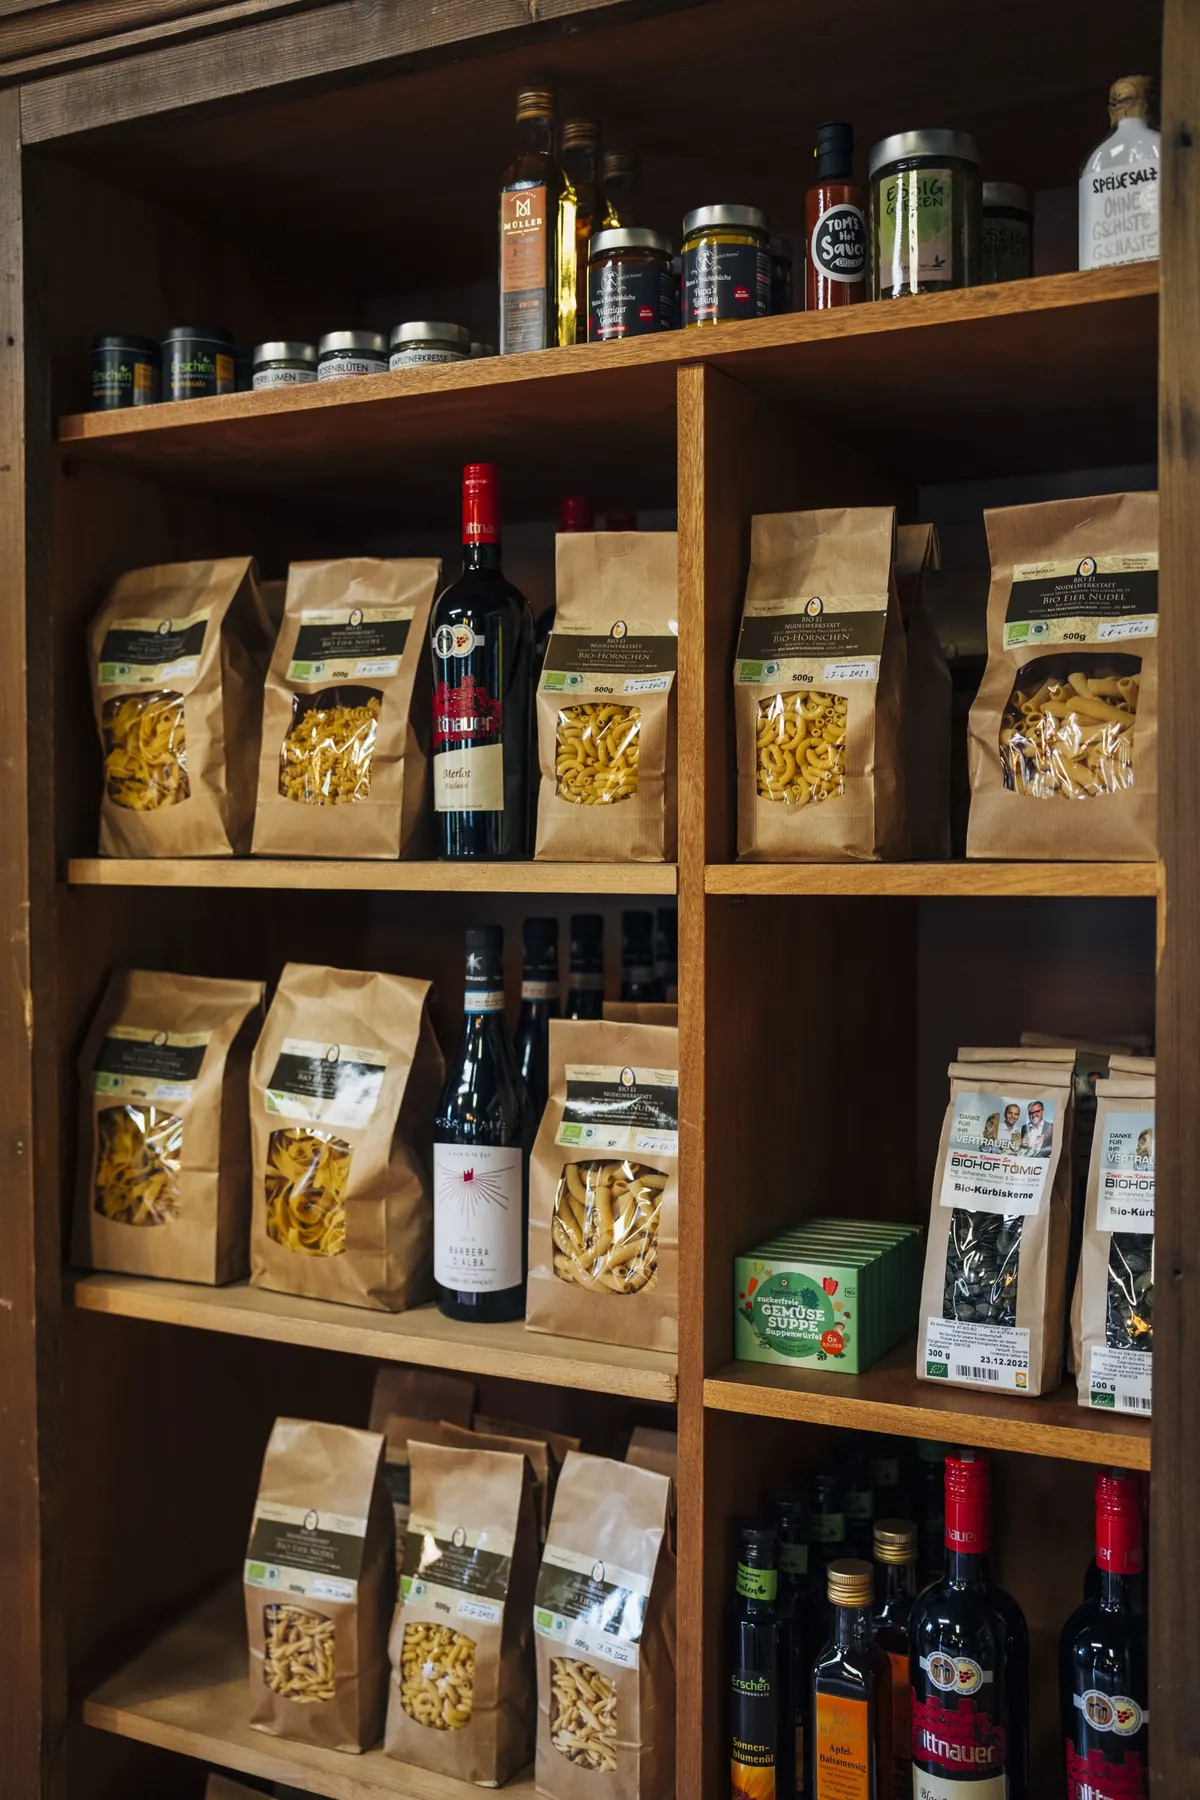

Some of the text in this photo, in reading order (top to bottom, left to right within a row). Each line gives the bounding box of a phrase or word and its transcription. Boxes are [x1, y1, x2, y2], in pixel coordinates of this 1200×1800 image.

[1092, 166, 1158, 194] SPEISESALZ
[1104, 190, 1141, 218] OHNE
[825, 215, 859, 233] TOM'S
[1073, 576, 1086, 584] BIO
[1054, 582, 1116, 592] NUDELWERKSTATT
[1042, 593, 1126, 604] BIO EIER NUDEL
[784, 622, 841, 630] NUDELWERKSTATT
[1062, 632, 1086, 642] 500g
[792, 673, 814, 683] 500g
[594, 686, 614, 694] 500g
[442, 766, 472, 779] Merlot
[603, 1091, 652, 1100] NUDELWERKSTATT
[959, 1114, 980, 1122] DANKE
[951, 1157, 1042, 1176] BIOHOF TOMIC
[954, 1183, 1034, 1199] Bio-Kürbiskerne
[449, 1245, 489, 1257] BARBERA
[756, 1296, 799, 1306] zuckerfreie
[761, 1304, 826, 1322] GEMÜSE
[768, 1316, 819, 1332] SUPPE
[765, 1328, 822, 1341] Suppenwürfel
[827, 1334, 837, 1343] 6x
[928, 1348, 943, 1358] 300
[980, 1356, 1028, 1368] 23.12.2022
[1091, 1380, 1108, 1390] 300
[731, 1674, 770, 1692] Erschen
[732, 1736, 770, 1752] Sonnen-
[828, 1744, 854, 1756] Apfel-
[732, 1748, 774, 1764] blumenöl
[820, 1753, 867, 1773] Balsamessig
